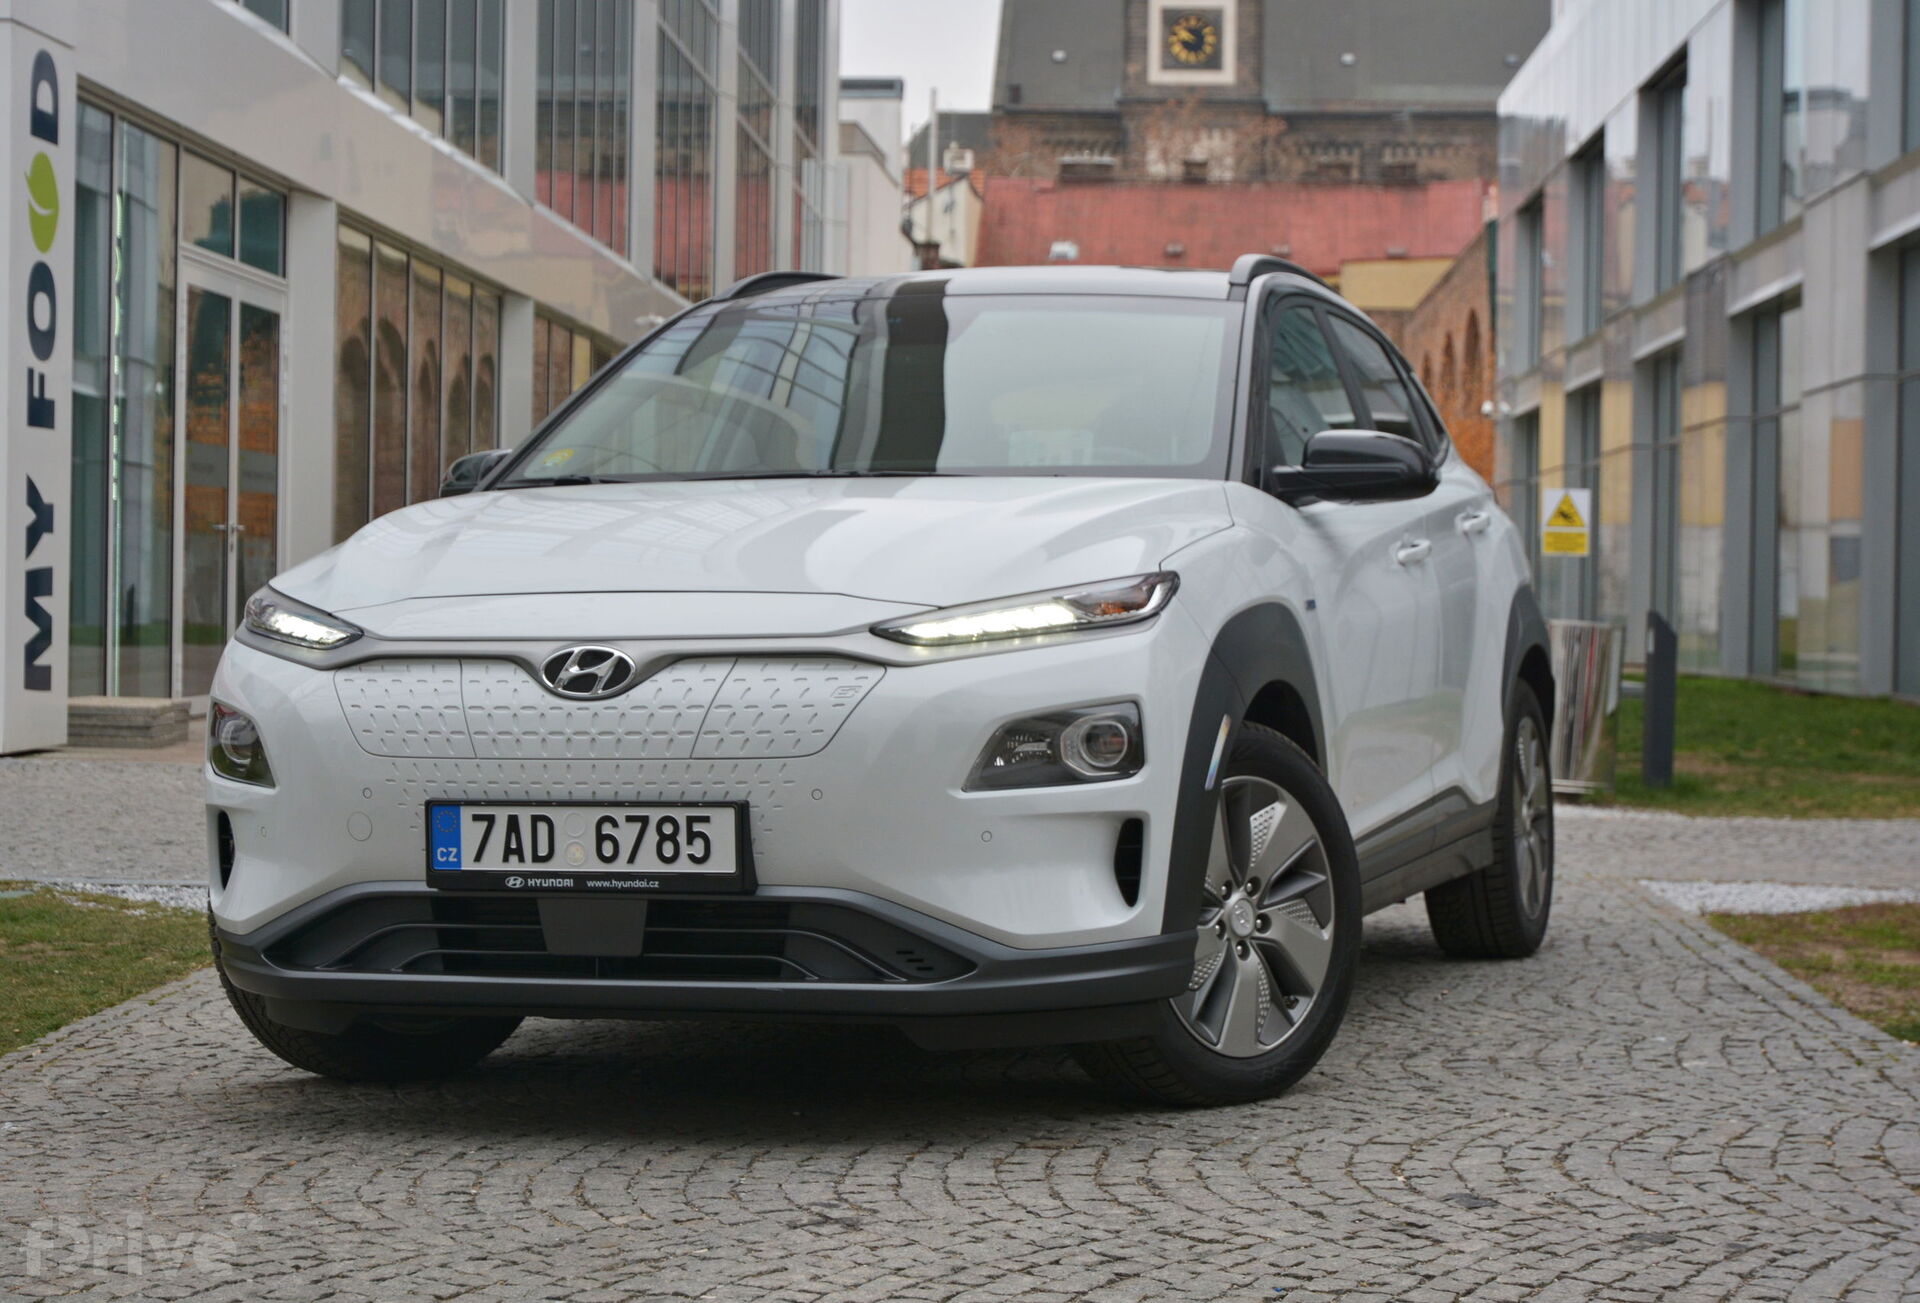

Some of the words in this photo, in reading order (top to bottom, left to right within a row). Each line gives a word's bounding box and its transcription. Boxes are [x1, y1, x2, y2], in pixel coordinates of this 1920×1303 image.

[24, 473, 54, 691] MY
[436, 846, 458, 863] CZ
[471, 813, 556, 864] 7AD
[594, 814, 712, 865] 6785
[527, 878, 574, 888] HYUNDAI
[585, 878, 660, 889] www.hyundai.cz
